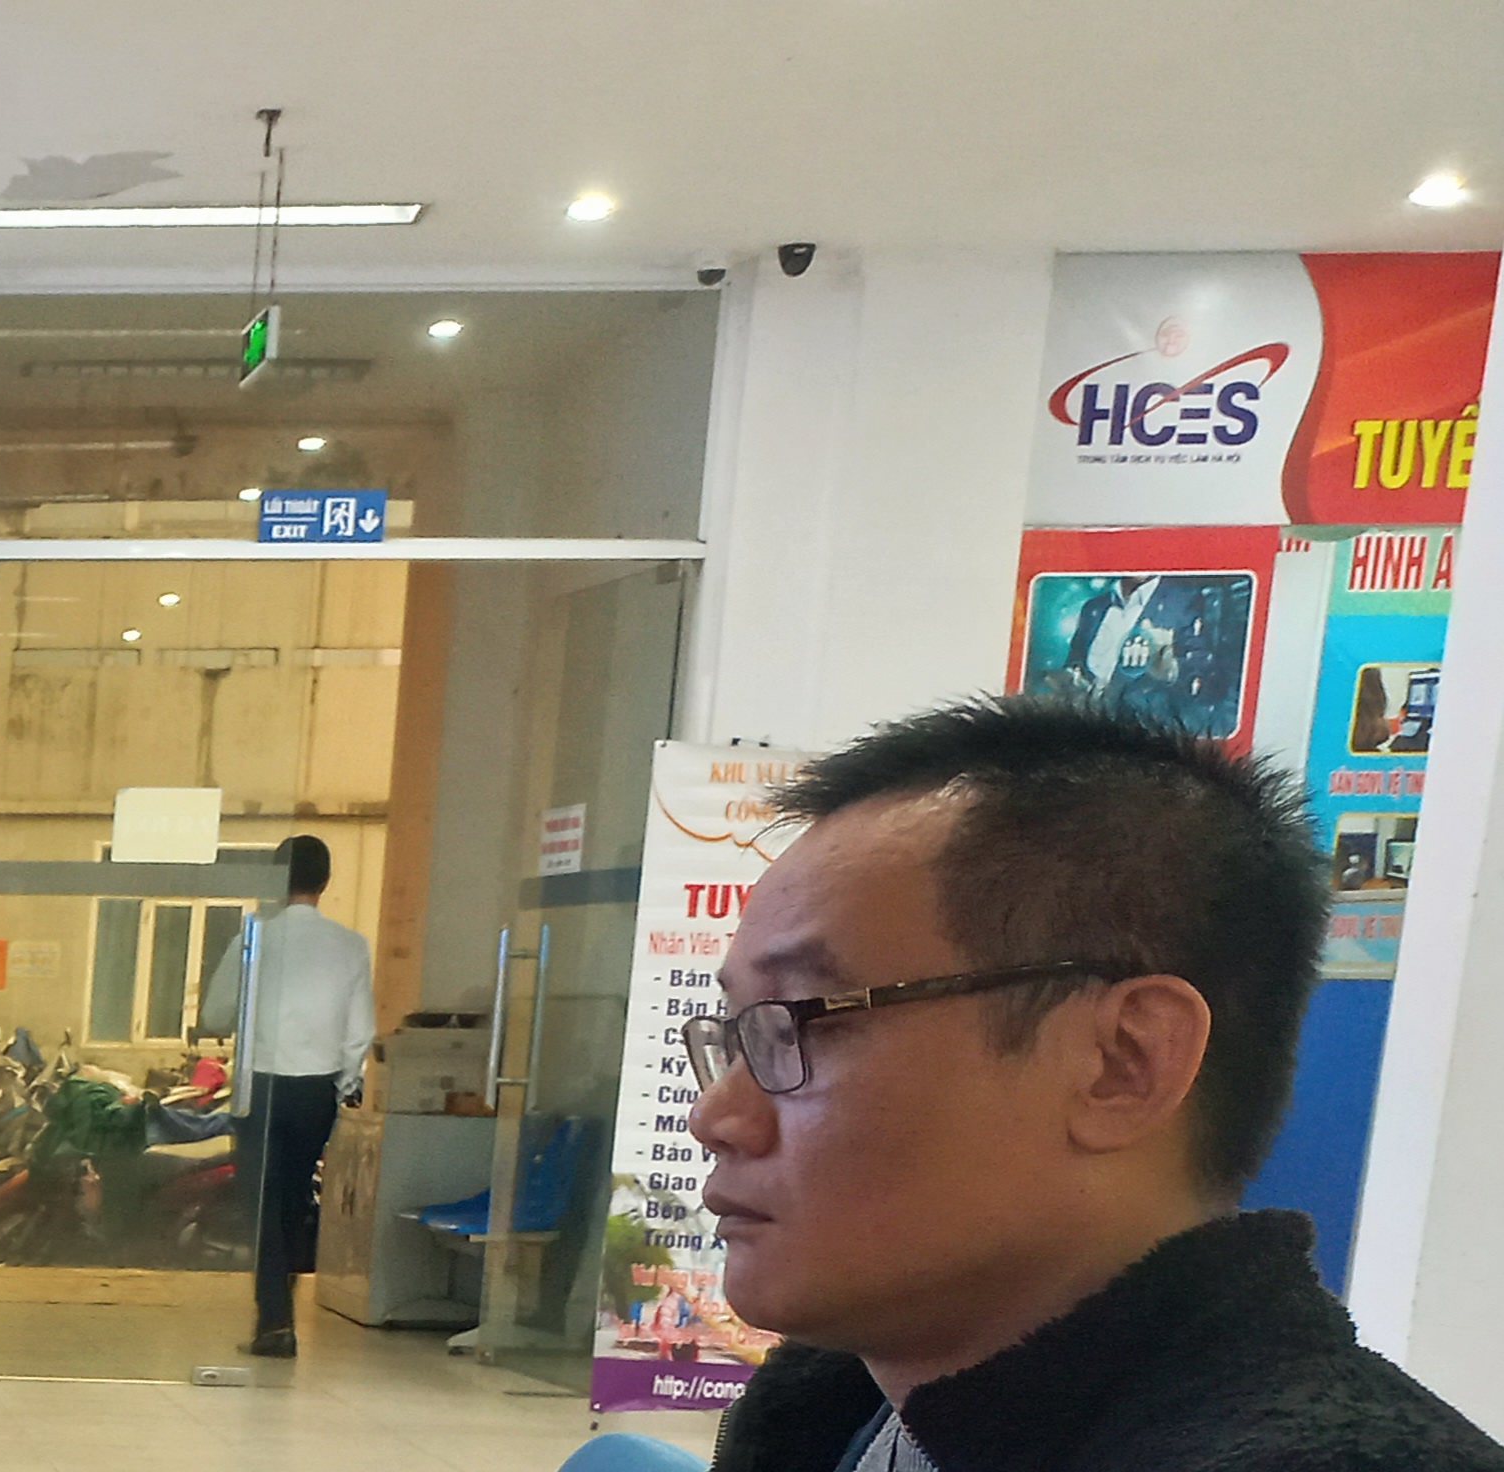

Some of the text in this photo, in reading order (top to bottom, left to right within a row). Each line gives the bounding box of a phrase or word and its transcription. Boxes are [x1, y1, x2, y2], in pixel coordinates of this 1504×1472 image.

[1077, 381, 1260, 446] HCES
[271, 524, 308, 538] EXIT
[660, 1055, 687, 1077] Kỹ
[651, 1142, 692, 1162] Bảo
[649, 1172, 697, 1191] Giao
